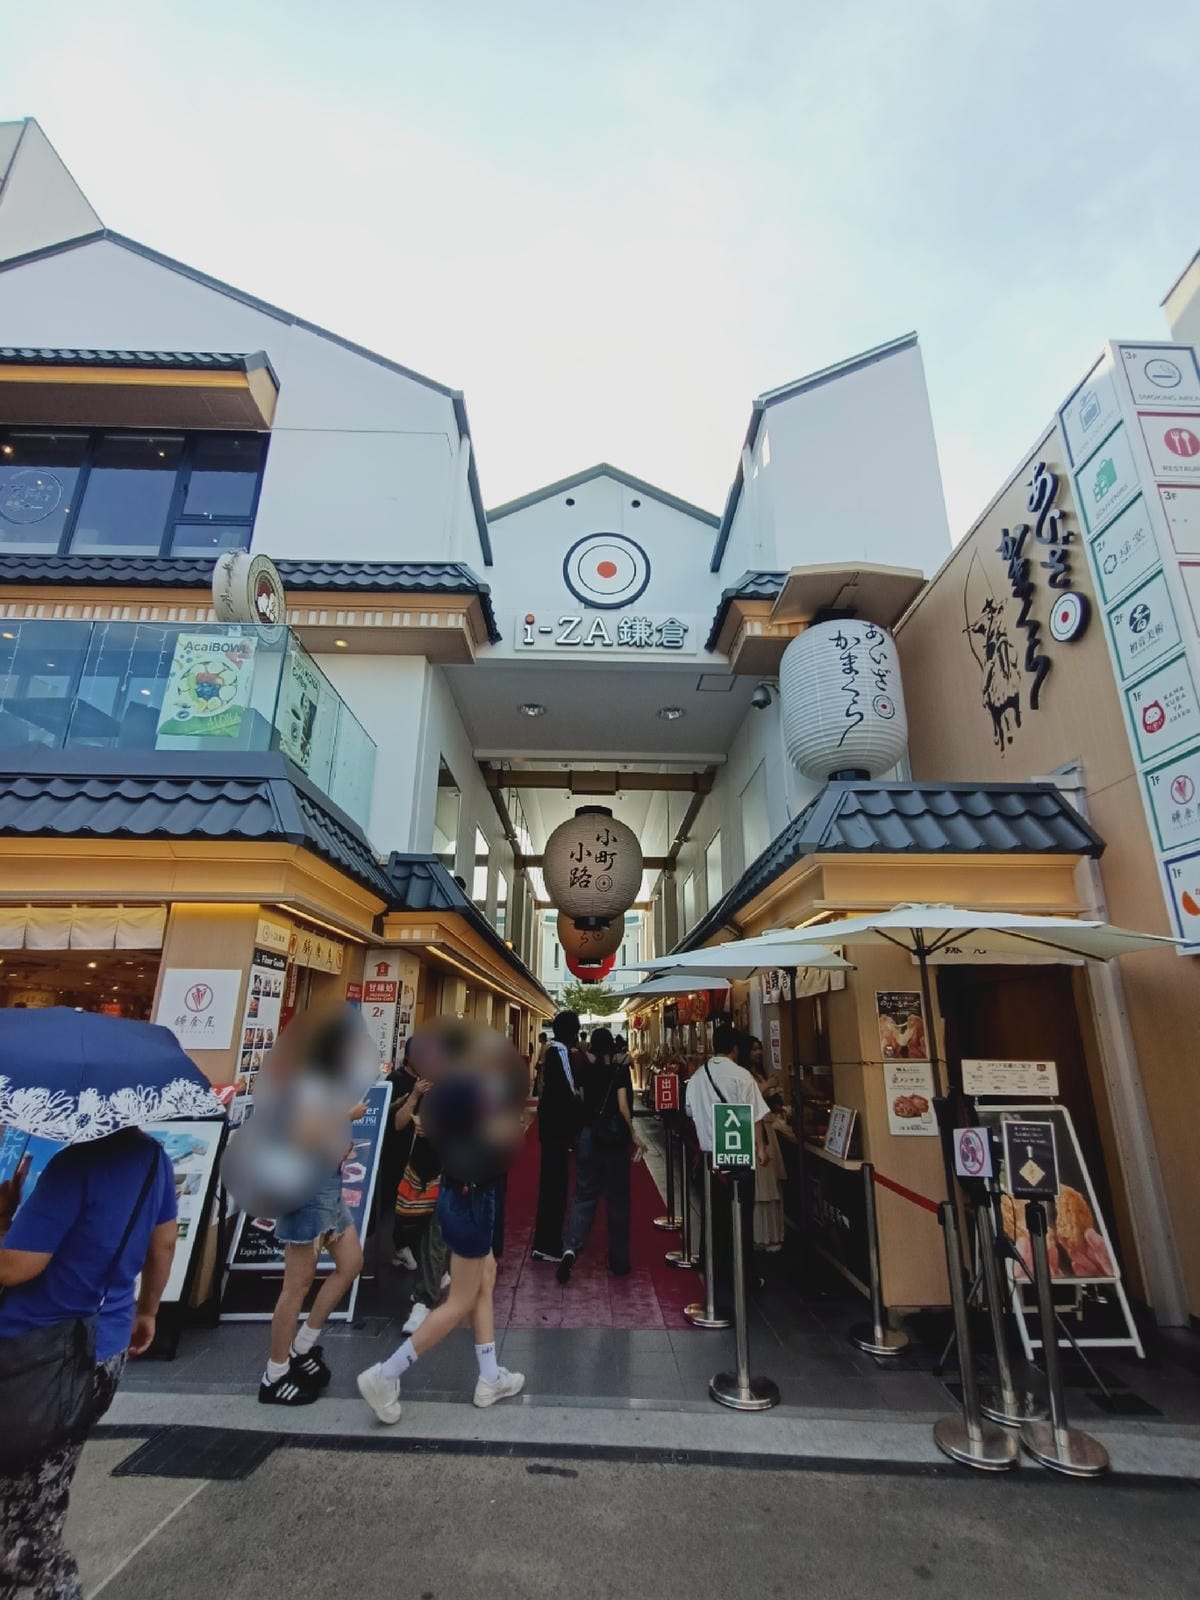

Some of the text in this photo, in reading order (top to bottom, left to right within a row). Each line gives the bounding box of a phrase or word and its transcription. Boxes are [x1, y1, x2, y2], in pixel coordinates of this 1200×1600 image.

[1162, 490, 1177, 501] 3F
[1113, 614, 1124, 626] 2F
[523, 613, 689, 648] i-ZA鎌倉
[1132, 691, 1142, 702] 1F
[1150, 775, 1161, 787] 1F
[594, 828, 618, 872] 小町
[569, 842, 593, 889] 小路
[1172, 867, 1182, 879] 1F
[372, 1006, 386, 1018] 2F
[661, 1078, 672, 1102] 出口
[724, 1109, 742, 1150] 入口
[717, 1153, 751, 1165] ENTER
